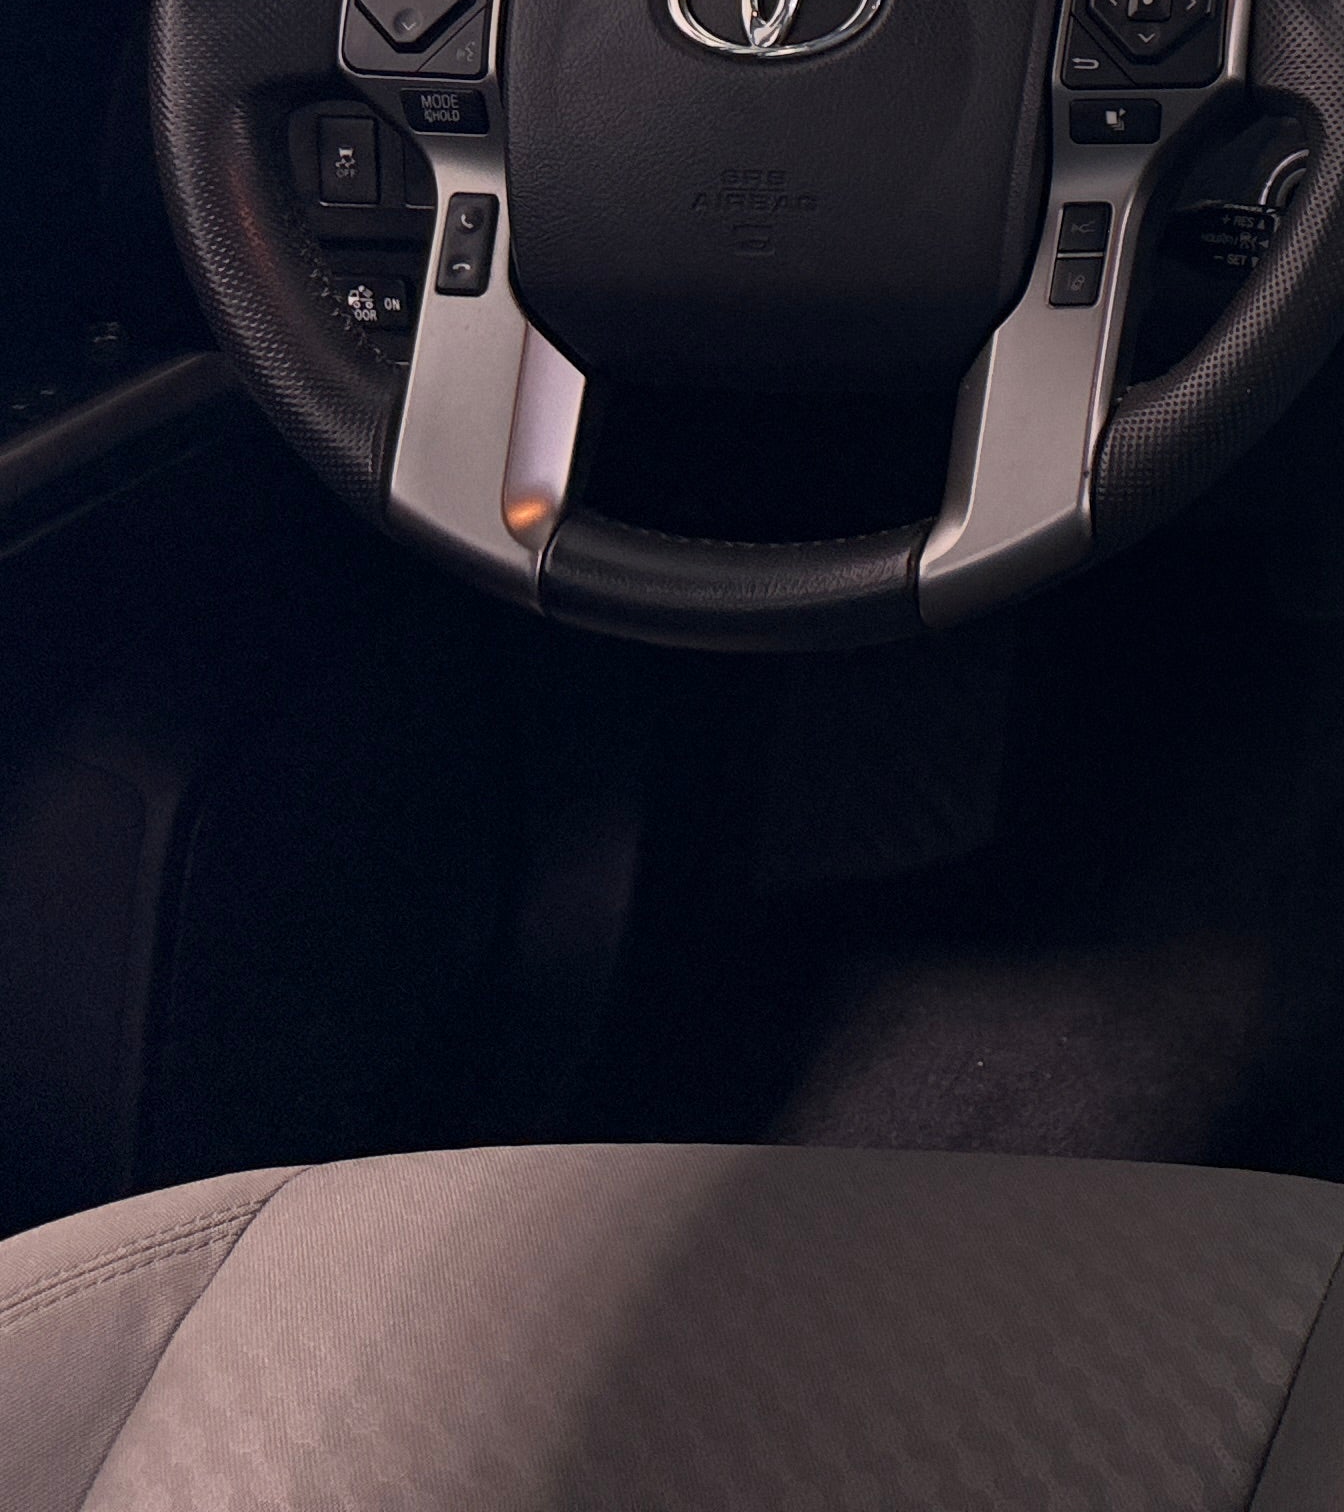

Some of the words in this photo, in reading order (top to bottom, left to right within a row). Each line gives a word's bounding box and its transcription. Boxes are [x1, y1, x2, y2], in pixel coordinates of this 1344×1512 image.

[421, 93, 460, 110] MODE
[432, 109, 460, 123] HOLD
[688, 191, 818, 212] AIRBAG
[383, 296, 401, 311] ON
[351, 308, 378, 323] OOR
